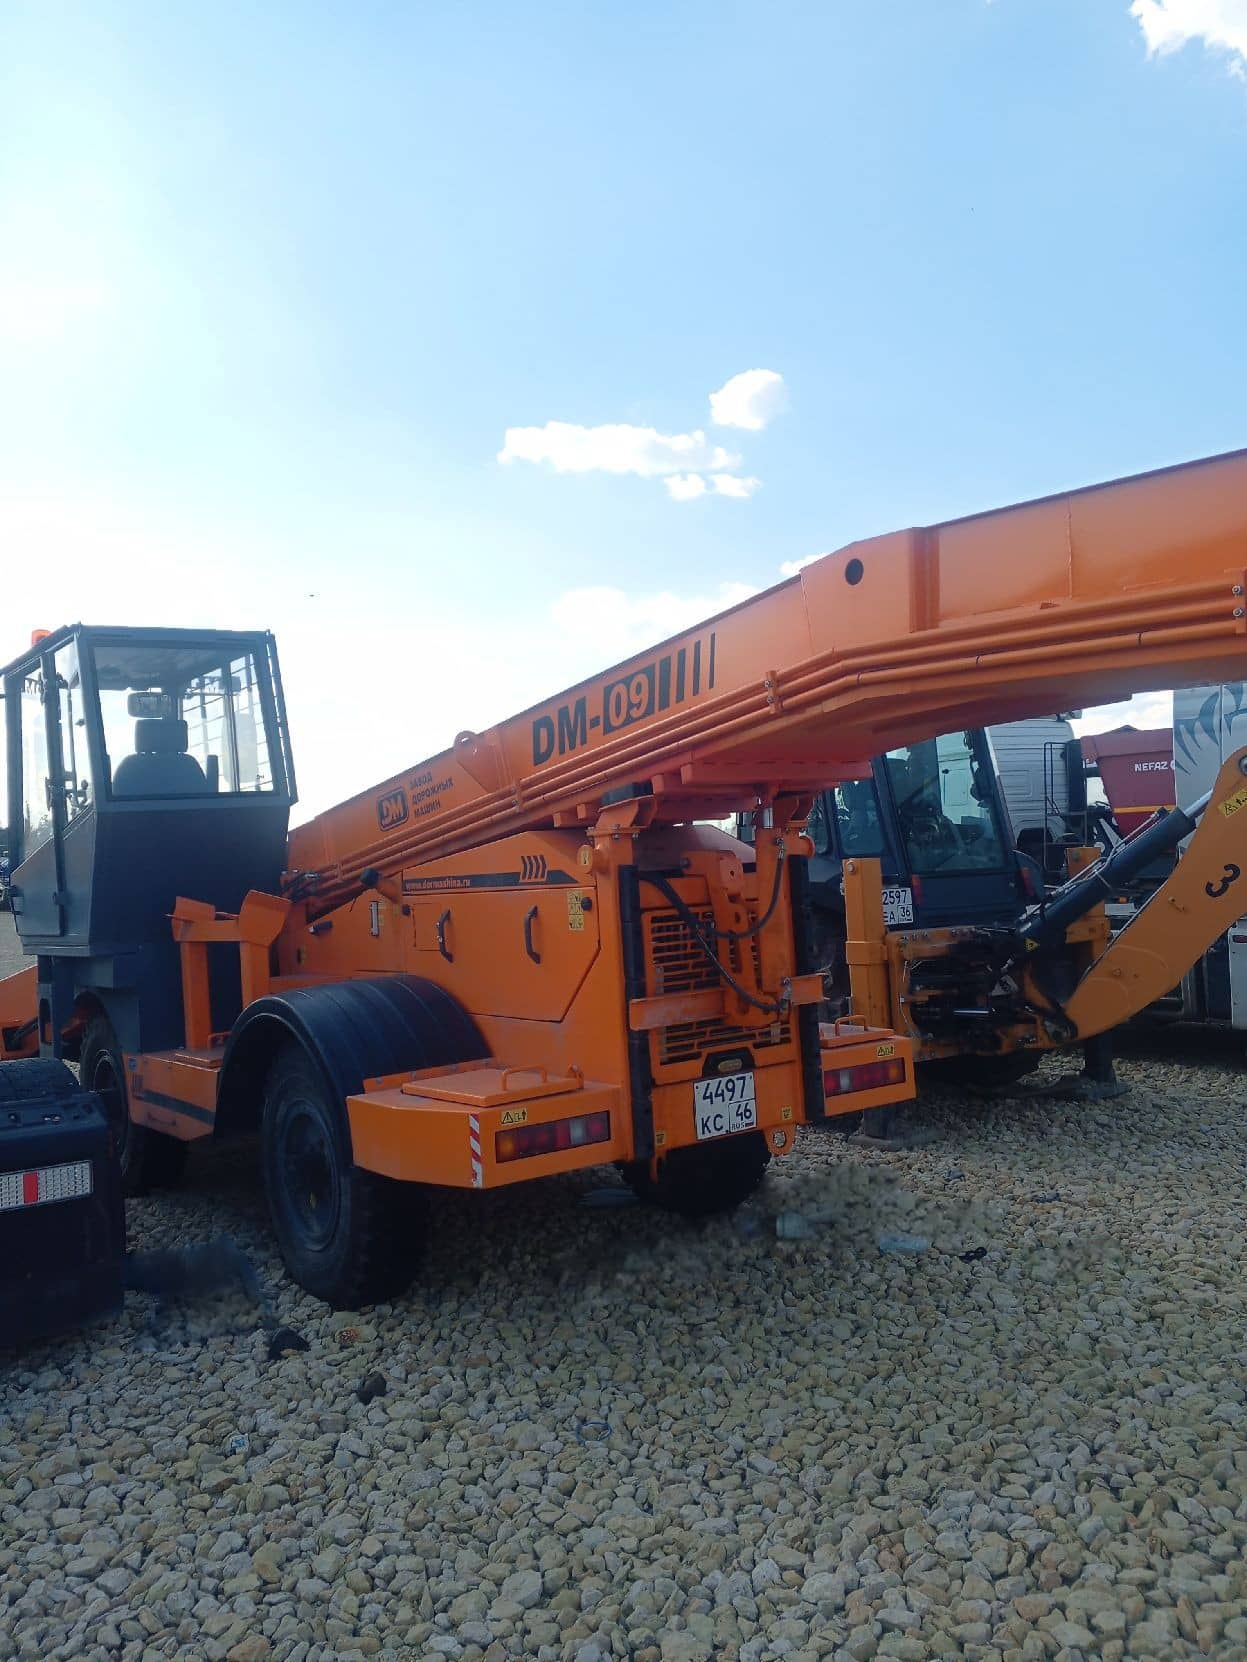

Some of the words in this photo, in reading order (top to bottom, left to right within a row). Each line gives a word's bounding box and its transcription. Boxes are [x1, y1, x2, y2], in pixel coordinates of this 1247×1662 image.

[533, 673, 650, 767] DM-09
[1134, 761, 1168, 772] NEFAZ
[412, 776, 454, 805] ДОРОЖНЫХ
[414, 799, 441, 818] МАШИН
[405, 877, 471, 891] www.dormashina.ru
[1205, 863, 1241, 898] 3
[882, 889, 907, 905] 2597
[900, 906, 911, 917] 36
[702, 1076, 746, 1104] 4497
[735, 1102, 752, 1121] 46
